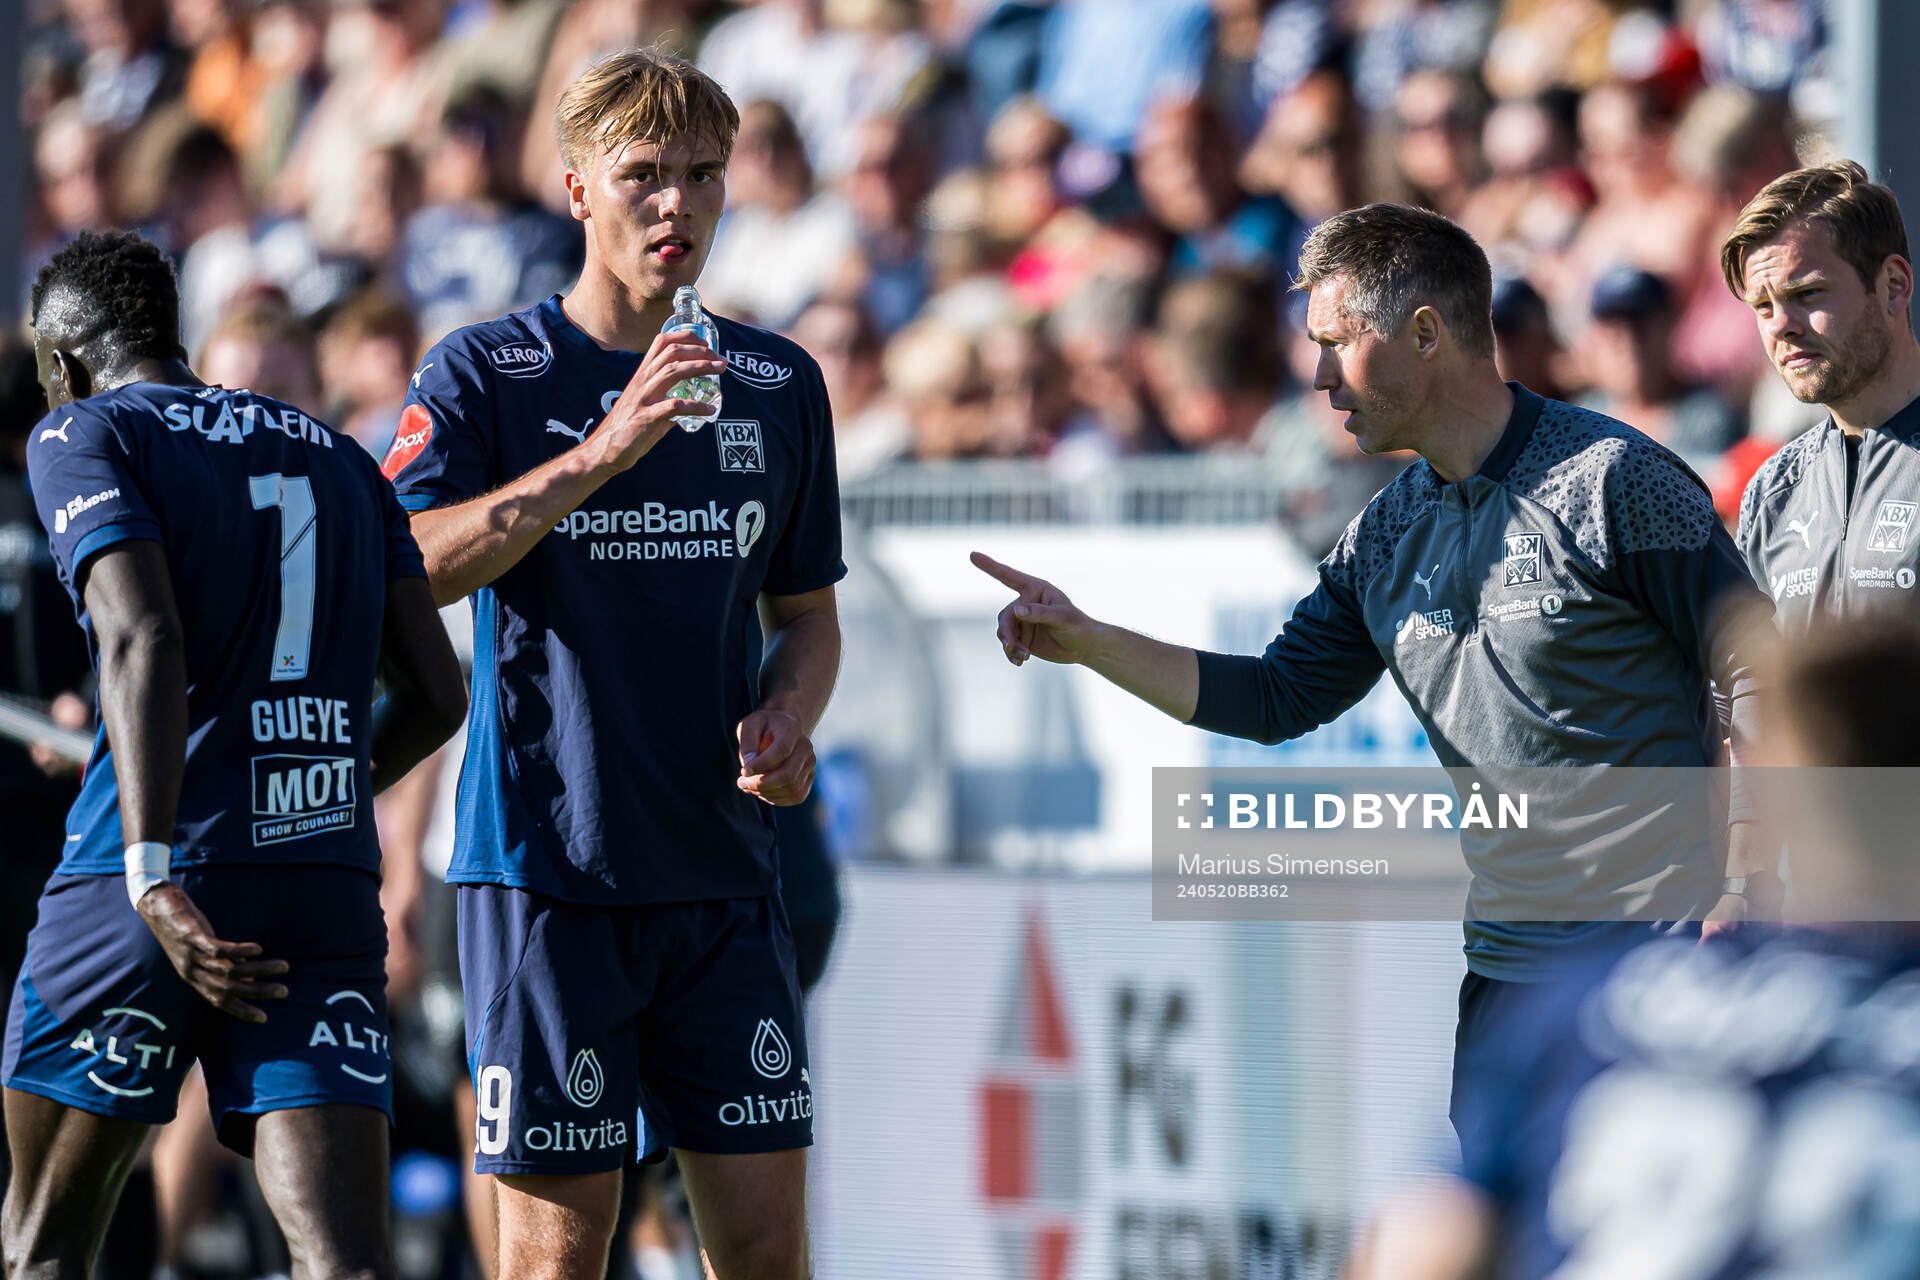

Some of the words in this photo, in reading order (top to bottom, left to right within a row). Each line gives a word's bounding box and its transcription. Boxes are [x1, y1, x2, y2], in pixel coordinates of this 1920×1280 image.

[491, 347, 547, 364] LERØY
[726, 350, 787, 380] LERØY
[590, 539, 733, 560] NORDMØRE
[1786, 567, 1818, 585] INTER
[1850, 567, 1895, 581] SpareBank
[1786, 581, 1817, 598] SPORT
[1415, 609, 1453, 627] INTER
[1487, 597, 1540, 617] SpareBank
[1415, 621, 1454, 640] SPORT
[251, 696, 352, 743] GUEYE
[267, 758, 355, 814] MOT
[261, 823, 293, 839] SHOW
[295, 811, 350, 832] COURAGE!
[70, 1028, 176, 1069] ALTI
[309, 1021, 391, 1060] ALTI
[719, 1089, 812, 1127] olivita
[524, 1118, 627, 1152] olivita
